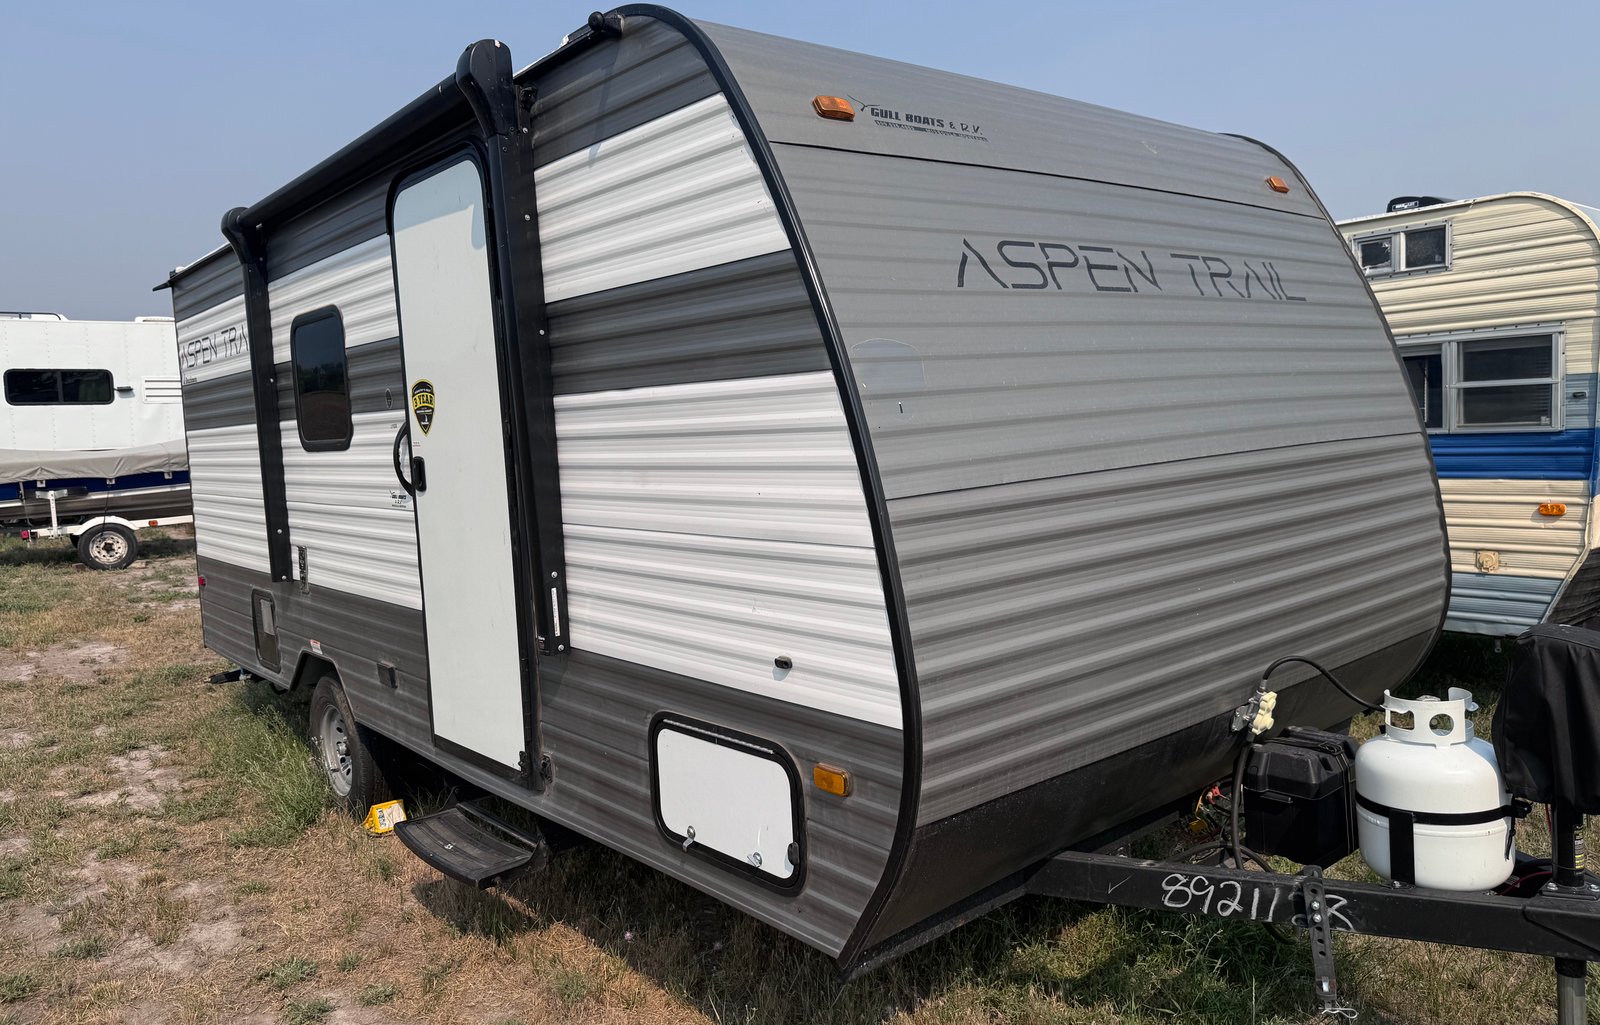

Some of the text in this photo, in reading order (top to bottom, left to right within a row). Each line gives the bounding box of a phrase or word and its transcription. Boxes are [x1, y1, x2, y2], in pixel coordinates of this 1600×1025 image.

[870, 107, 901, 121] GULL
[905, 113, 945, 128] BOATS
[949, 121, 956, 130] &
[957, 238, 1307, 302] ASPEN TRAIL
[180, 324, 249, 370] ASPEN TRA
